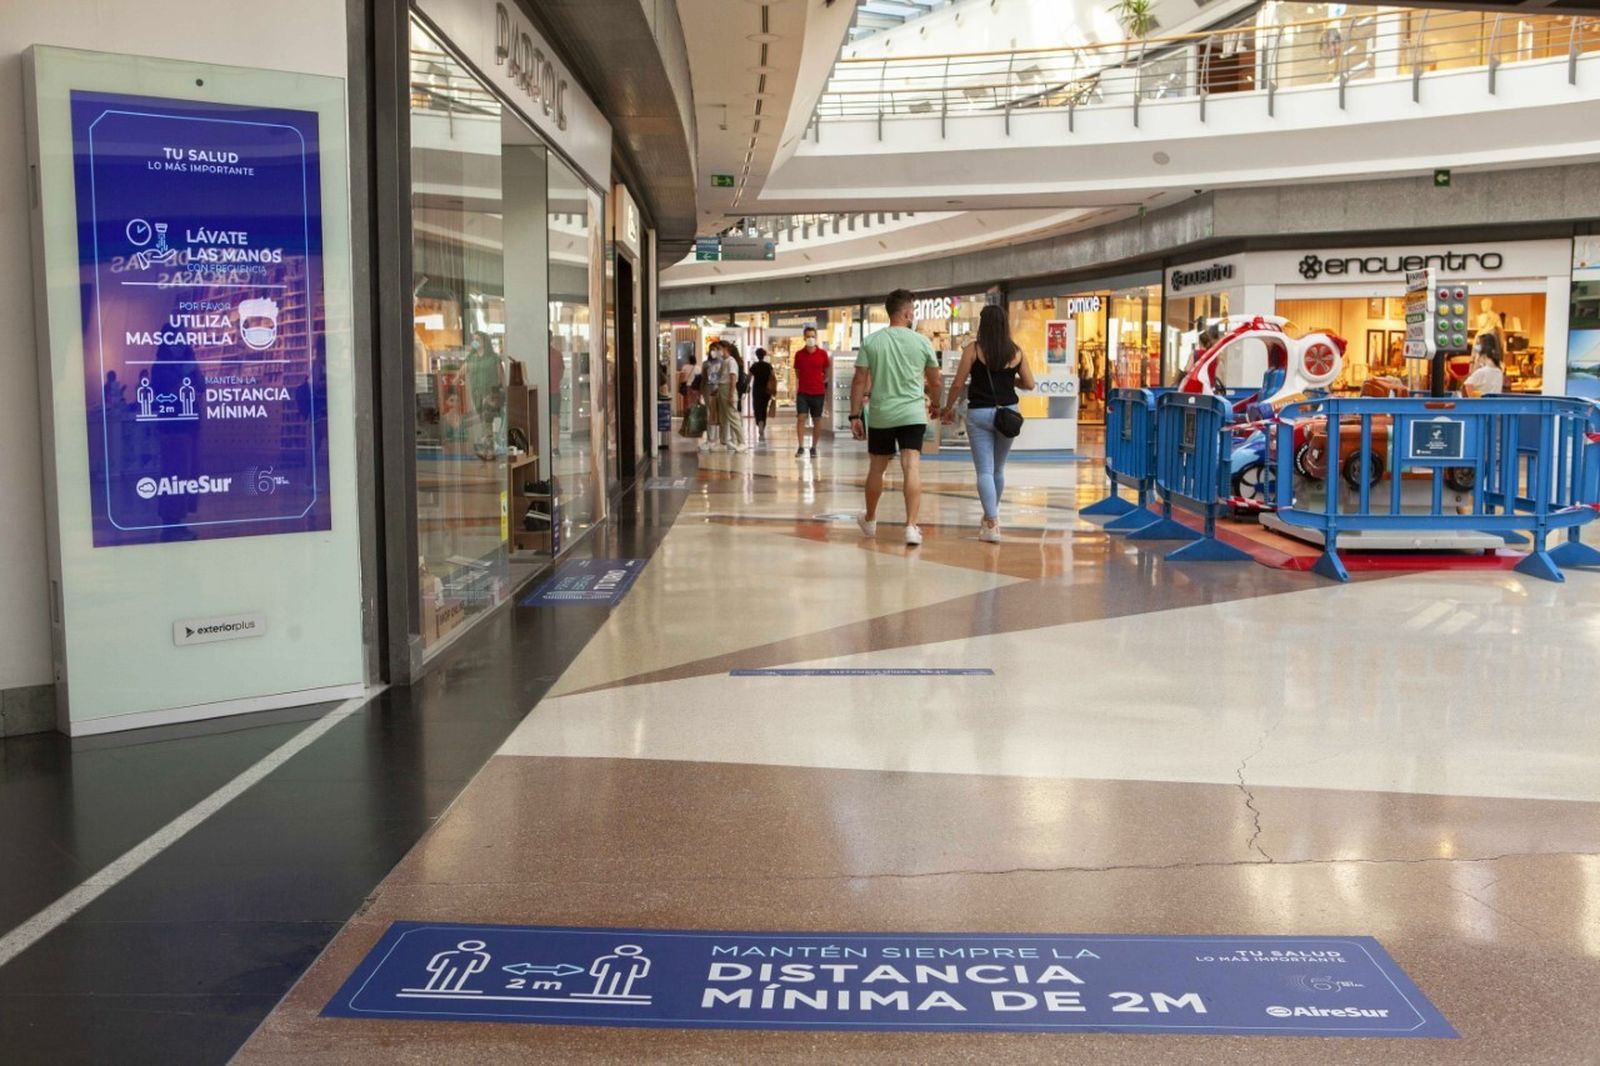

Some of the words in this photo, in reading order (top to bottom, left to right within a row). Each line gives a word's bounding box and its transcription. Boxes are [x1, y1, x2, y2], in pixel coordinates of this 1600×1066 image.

[163, 147, 183, 160] TU
[188, 149, 239, 164] SALUD
[147, 161, 162, 170] LO
[165, 161, 188, 172] MÁS
[190, 164, 255, 176] IMPORTANTE
[186, 227, 248, 245] LÁVATE
[186, 247, 219, 262] LAS
[223, 249, 283, 264] MANOS
[1324, 250, 1503, 276] encuentro
[186, 263, 209, 272] CON
[179, 301, 198, 311] POR
[201, 302, 231, 311] FAVOR
[913, 297, 952, 321] amas
[169, 314, 232, 328] UTILIZA
[126, 332, 233, 346] MASCARILLA
[245, 377, 257, 385] LA
[205, 388, 290, 402] DISTANCIA
[207, 403, 268, 419] MÍNIMA
[157, 475, 232, 496] AireSur
[197, 620, 256, 635] exteriorplus
[711, 945, 867, 958] MANTÉN
[881, 947, 1040, 959] SIEMPRE
[1052, 948, 1101, 960] LA
[707, 962, 1086, 985] DISTANCIA
[701, 983, 968, 1012] MÍNIMA
[990, 990, 1087, 1013] DE
[1108, 990, 1208, 1014] 2M
[1291, 1006, 1390, 1018] AireSur
